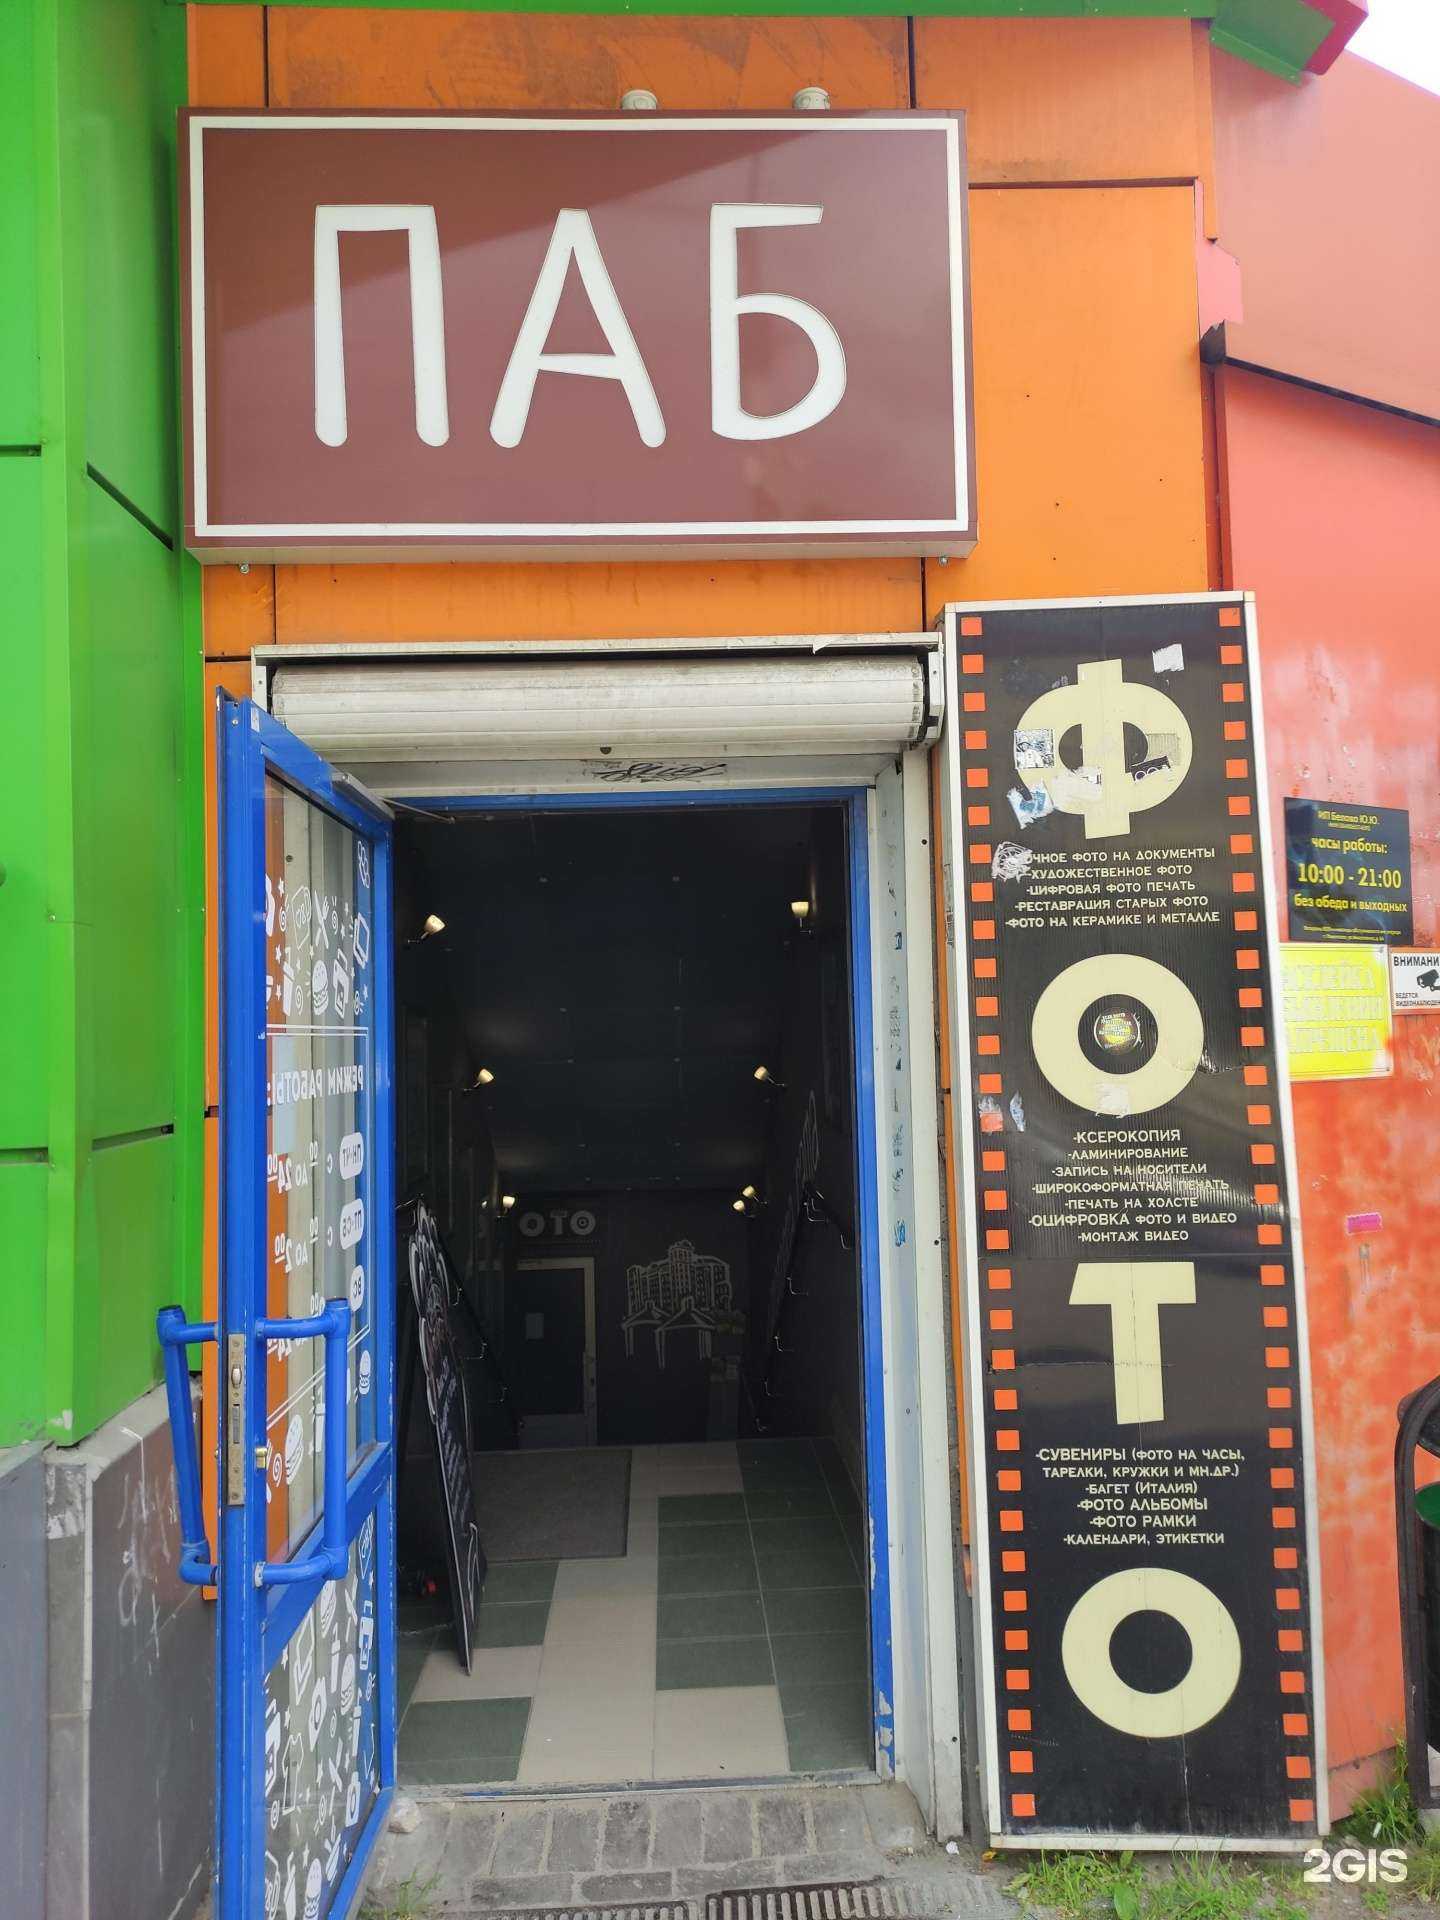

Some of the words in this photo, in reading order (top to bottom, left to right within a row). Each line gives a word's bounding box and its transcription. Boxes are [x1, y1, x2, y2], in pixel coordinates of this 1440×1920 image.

[314, 203, 847, 448] ПАБ
[1311, 837, 1341, 850] часы
[1343, 837, 1388, 854] работы:
[1071, 851, 1108, 862] ФОТО
[1112, 851, 1131, 861] НА
[1135, 847, 1215, 861] ДОКУМЕНТЫ
[1156, 864, 1193, 875] ФОТО
[1297, 862, 1345, 884] 10:00
[1357, 867, 1402, 889] 21:00
[1105, 882, 1142, 893] ФОТО
[1146, 880, 1196, 892] ПЕЧАТЬ
[1115, 897, 1168, 909] СТАРЫХ
[1172, 895, 1209, 907] ФОТО
[1294, 893, 1314, 907] без
[1314, 894, 1350, 911] обеда
[1350, 901, 1358, 909] и
[1359, 900, 1408, 913] выходных
[1049, 916, 1068, 927] НА
[1072, 914, 1142, 926] КЕРАМИКЕ
[1146, 914, 1156, 924] И
[1161, 911, 1220, 924] МЕТАЛЛЕ
[1112, 1165, 1133, 1176] НА
[1137, 1163, 1208, 1175] НОСИТЕЛИ
[1178, 1178, 1230, 1192] ПЕЧАТЬ
[1122, 1198, 1143, 1209] НА
[1147, 1196, 1200, 1208] ХОЛСТЕ
[1135, 1213, 1172, 1225] ФОТО
[1176, 1213, 1187, 1224] И
[1191, 1212, 1238, 1224] ВИДЕО
[1144, 1230, 1189, 1242] ВИДЕО
[1178, 1449, 1197, 1460] НА
[1112, 1466, 1169, 1478] КРУЖКИ
[1174, 1466, 1184, 1477] И
[1130, 1497, 1208, 1511] АЛЬБОМЫ
[1142, 1514, 1197, 1528] РАМКИ
[1155, 1532, 1225, 1544] ЭТИКЕТКИ
